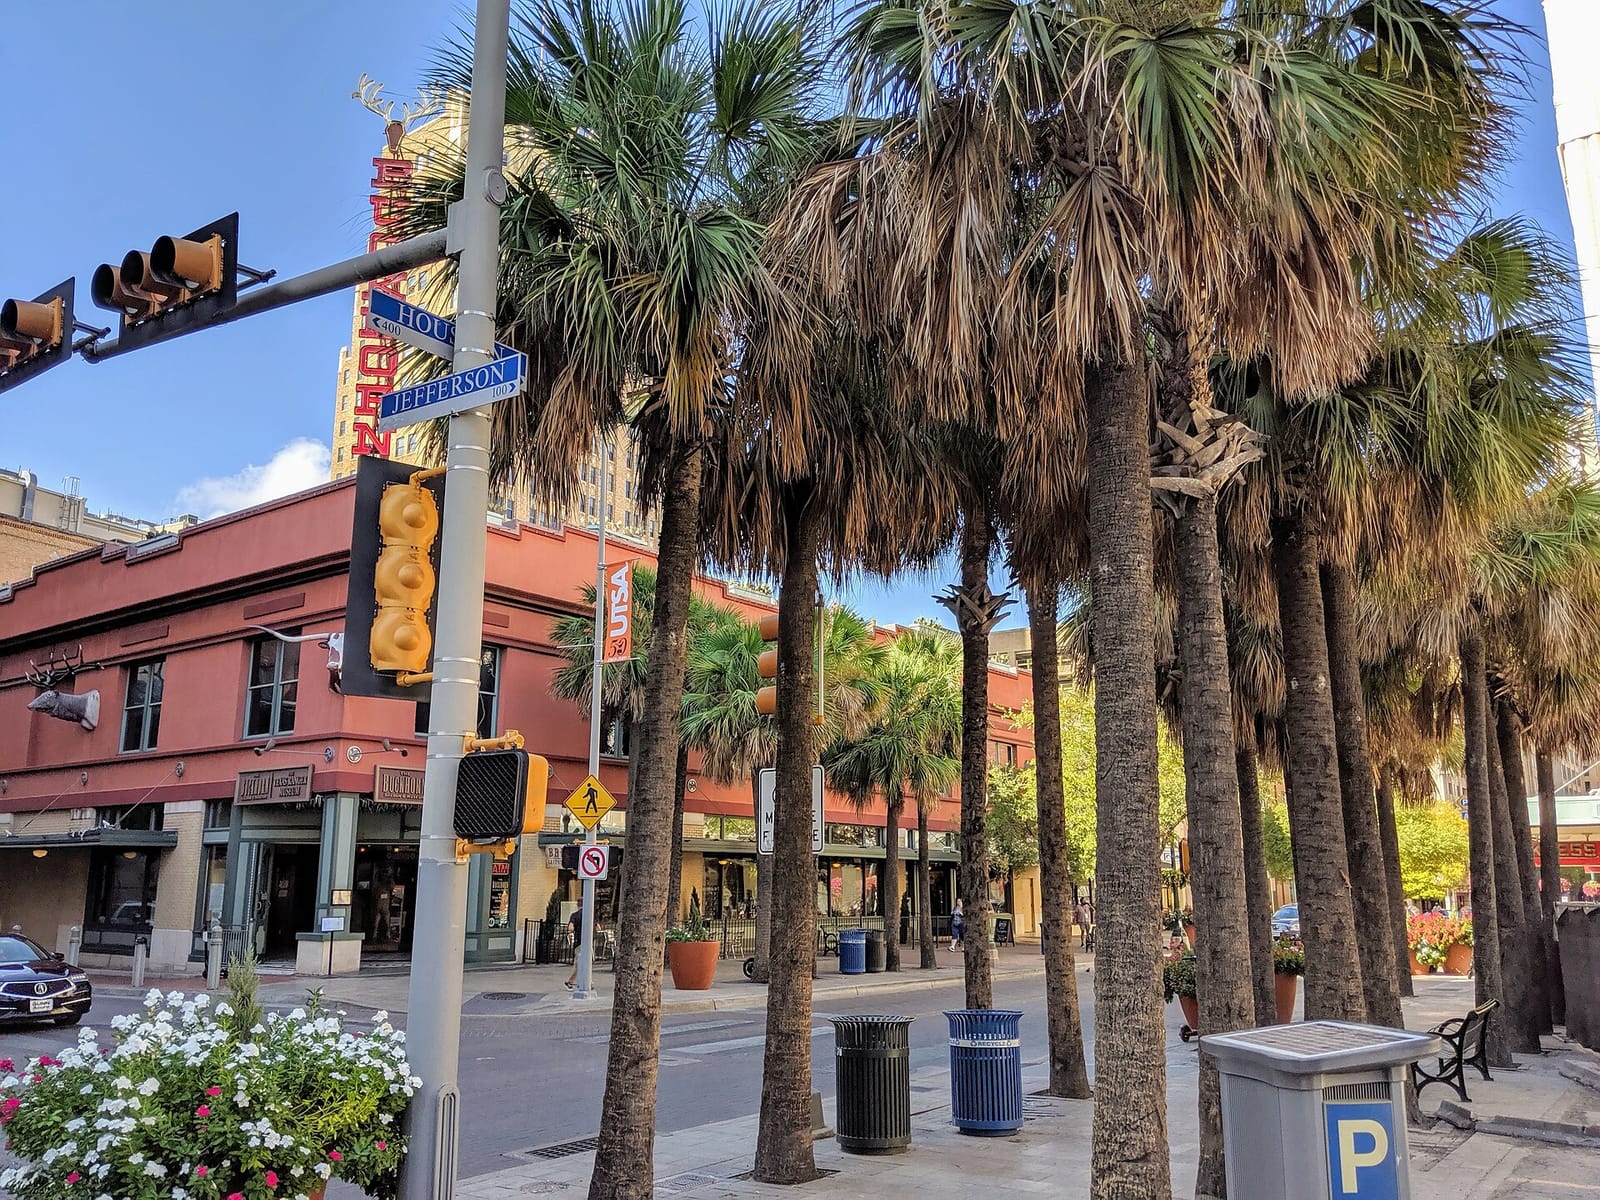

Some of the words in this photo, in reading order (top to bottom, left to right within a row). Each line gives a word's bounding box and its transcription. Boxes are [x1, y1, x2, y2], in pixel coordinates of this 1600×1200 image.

[381, 320, 401, 337] 400
[391, 361, 506, 414] JEFFERSON
[492, 384, 508, 398] 100
[610, 562, 629, 637] UTSA
[492, 864, 508, 873] ATM
[1337, 1119, 1388, 1194] P
